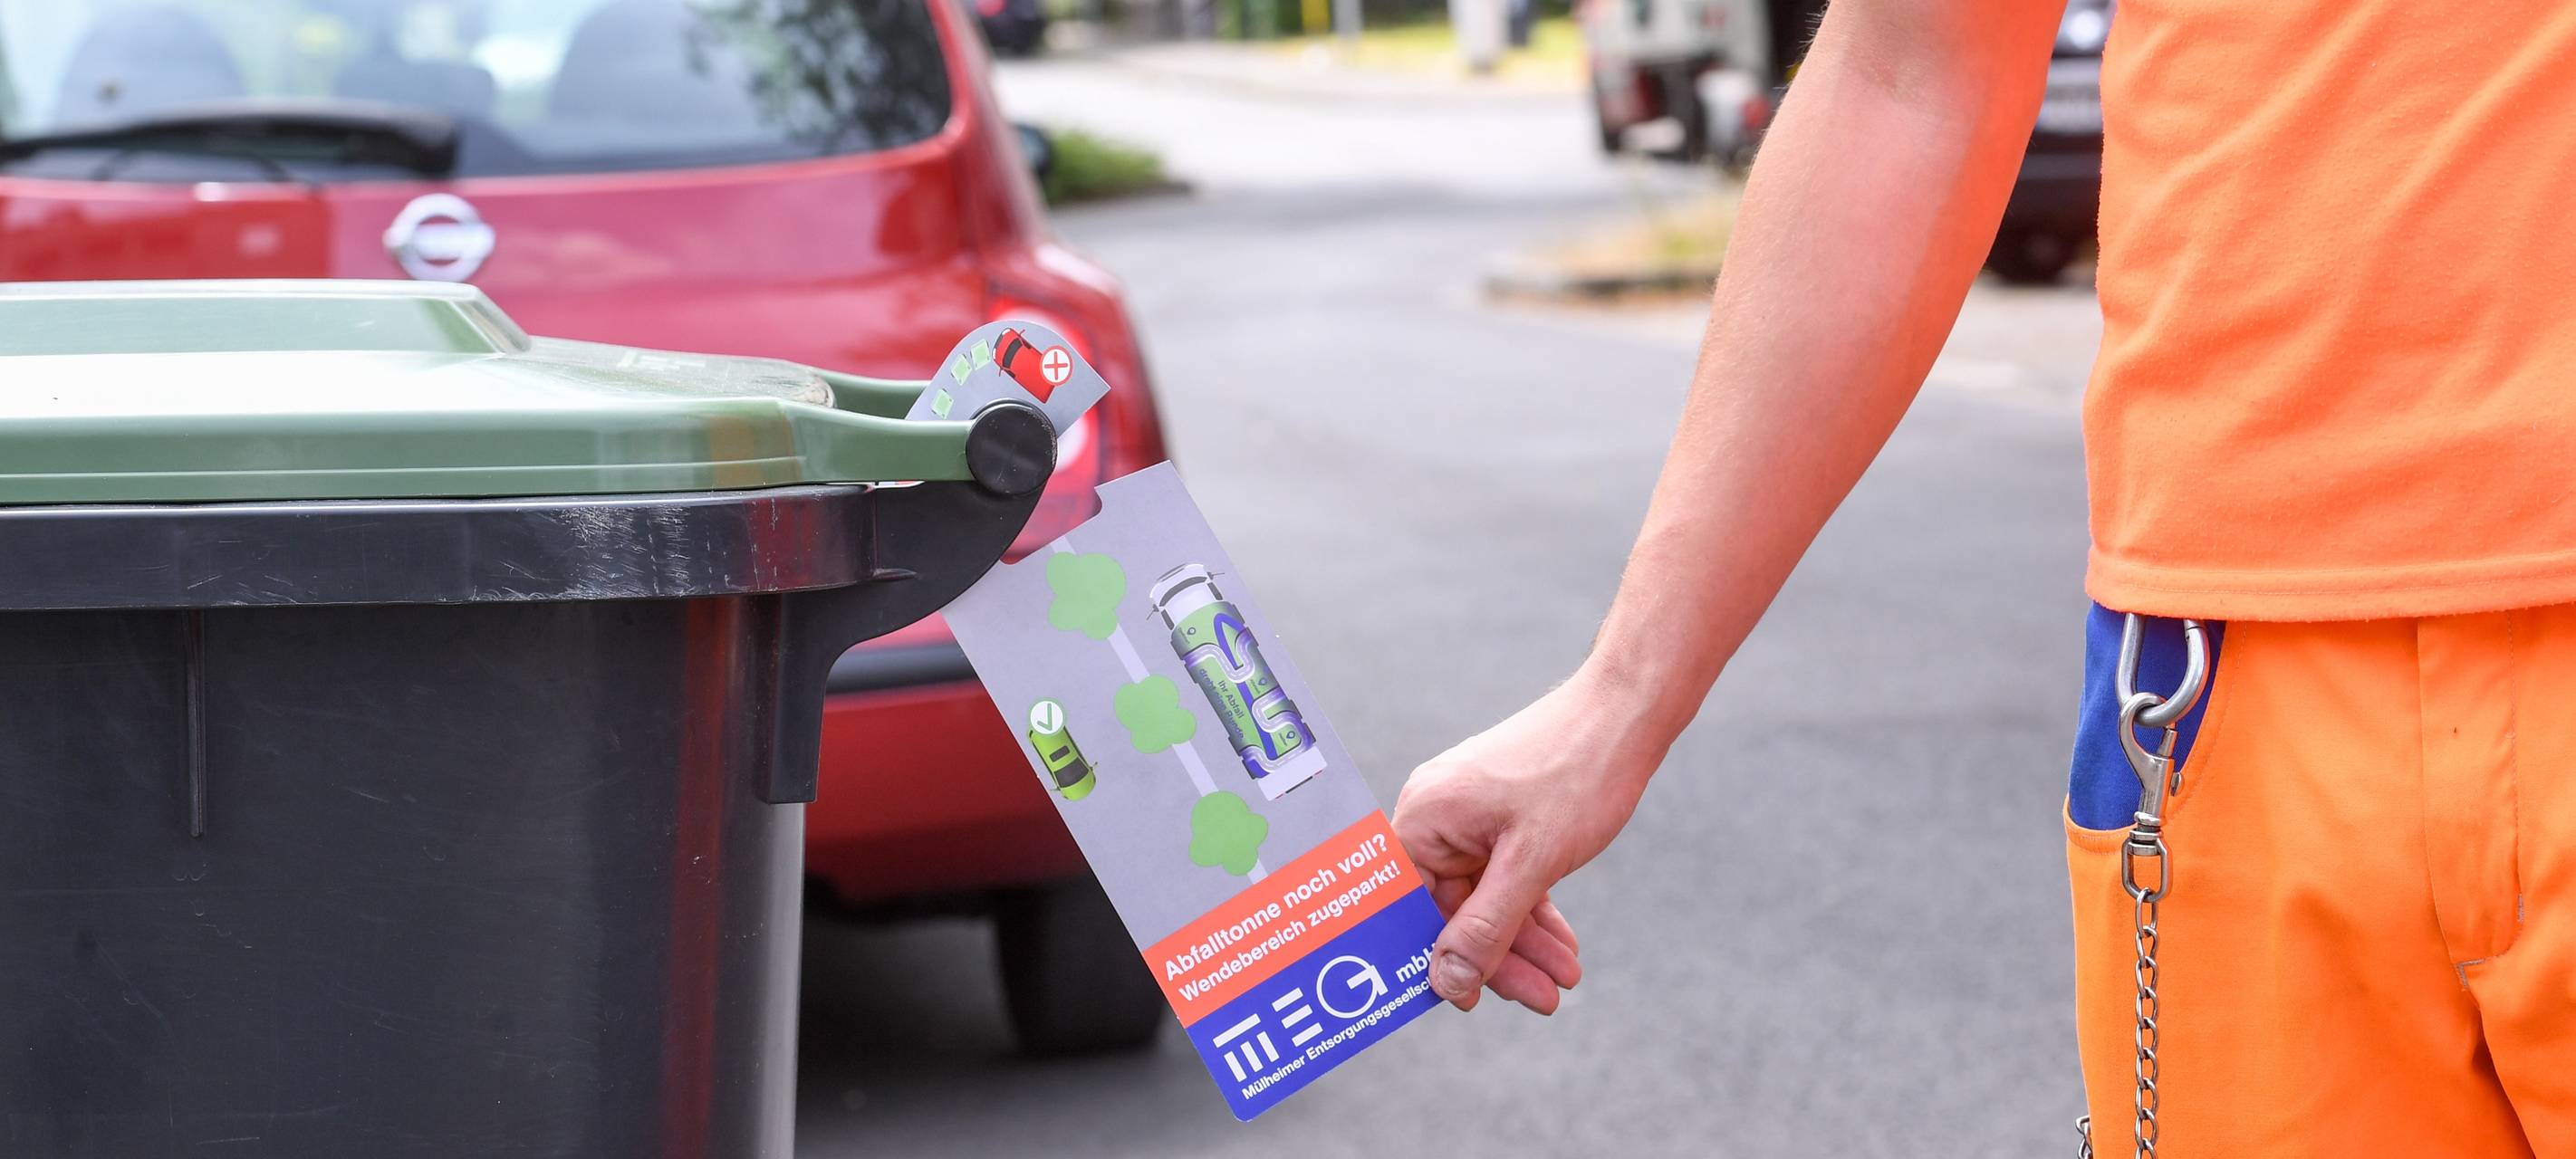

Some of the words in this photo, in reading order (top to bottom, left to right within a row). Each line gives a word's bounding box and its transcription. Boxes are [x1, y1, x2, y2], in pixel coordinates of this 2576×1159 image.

[1226, 694, 1245, 719] Abfall
[1164, 902, 1282, 982] Abfalltonne
[1283, 867, 1337, 909] noch
[1337, 833, 1388, 875] voll?
[1177, 920, 1307, 1001] Wendebereich
[1306, 859, 1401, 927] zugeparkt!
[1241, 1055, 1305, 1100] Mülheimer
